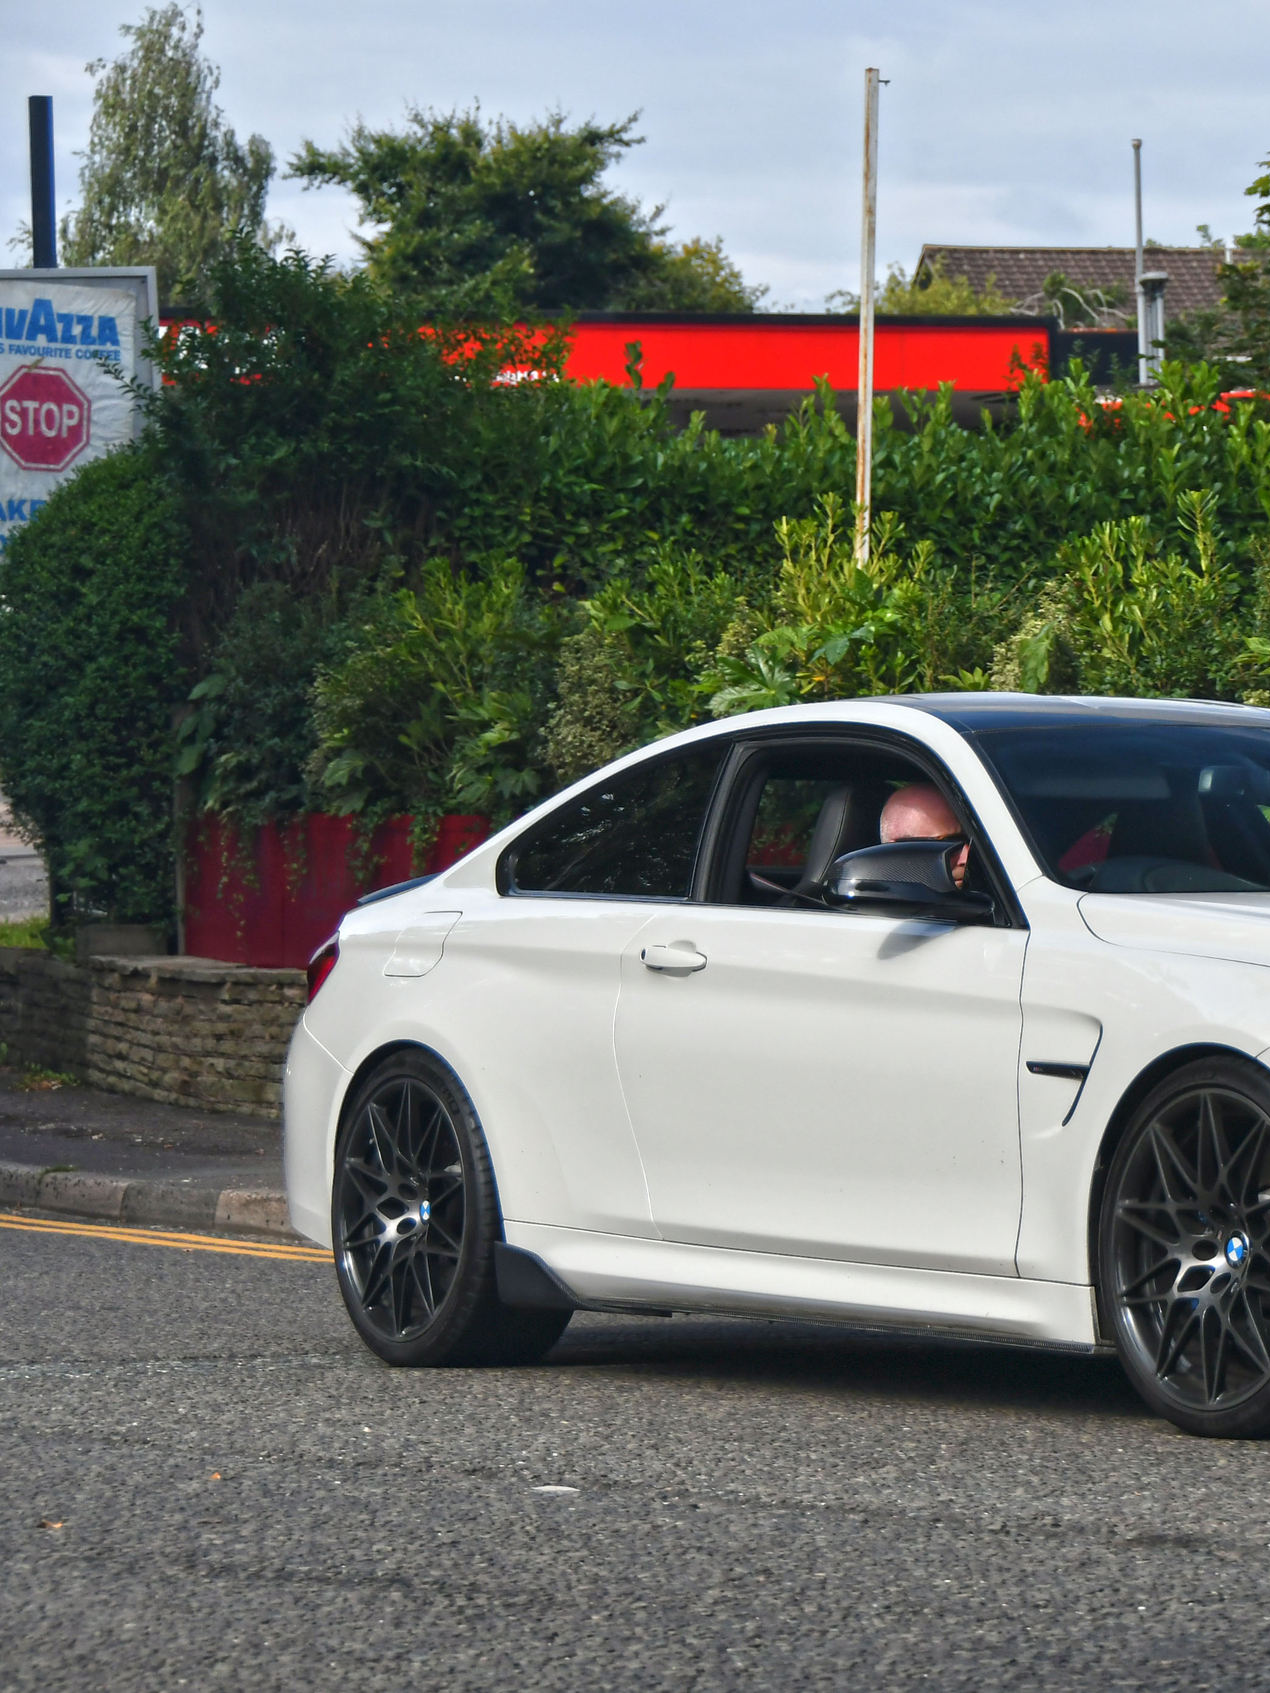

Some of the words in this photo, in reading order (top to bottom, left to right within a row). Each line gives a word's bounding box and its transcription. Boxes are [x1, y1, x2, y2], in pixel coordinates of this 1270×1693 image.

[0, 297, 120, 346] VAZZA
[8, 343, 72, 359] FAVOURITE
[75, 348, 121, 361] COFEE
[4, 400, 80, 438] STOP
